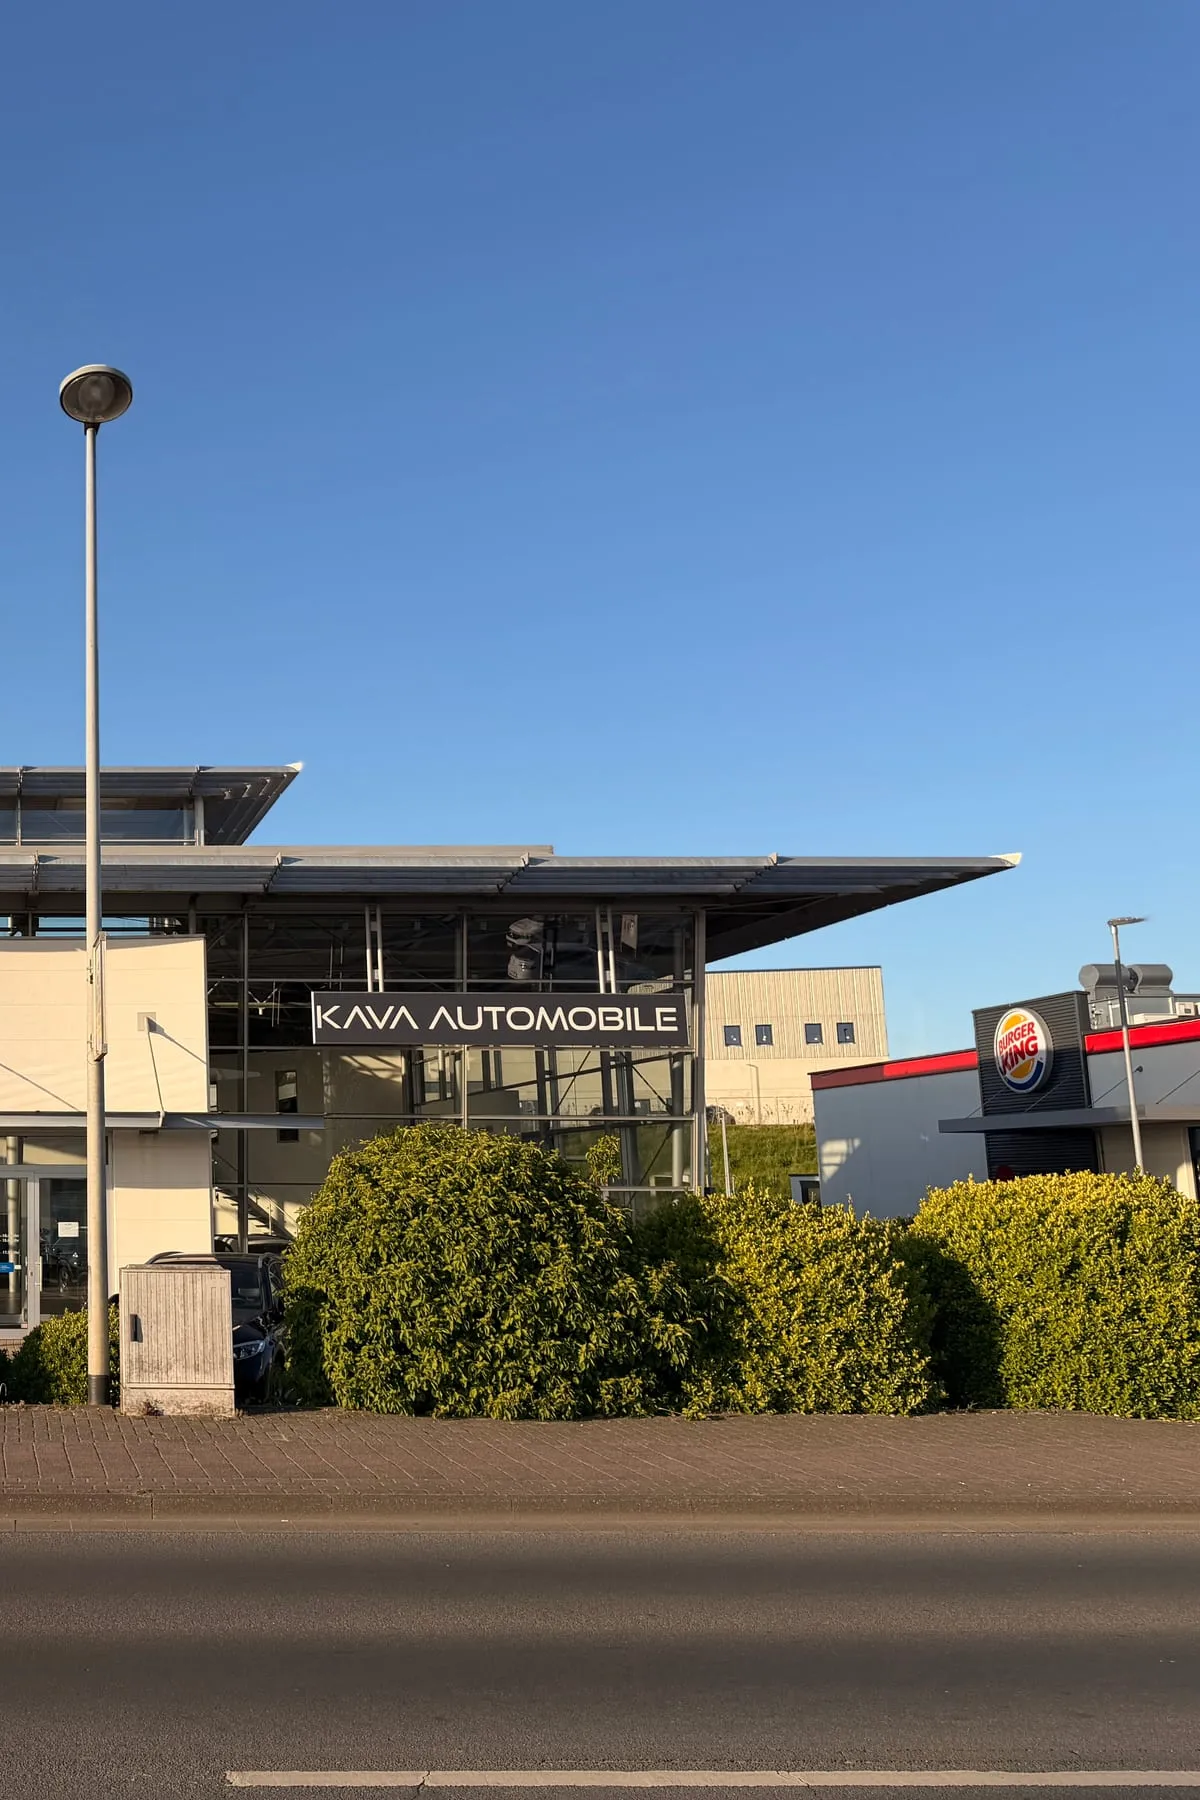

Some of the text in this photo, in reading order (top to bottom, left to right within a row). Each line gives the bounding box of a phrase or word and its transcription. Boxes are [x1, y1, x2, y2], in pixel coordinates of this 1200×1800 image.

[315, 1005, 679, 1032] KAVA AUTOMOBILE
[998, 1021, 1036, 1055] BURGER
[1001, 1035, 1039, 1076] KING
